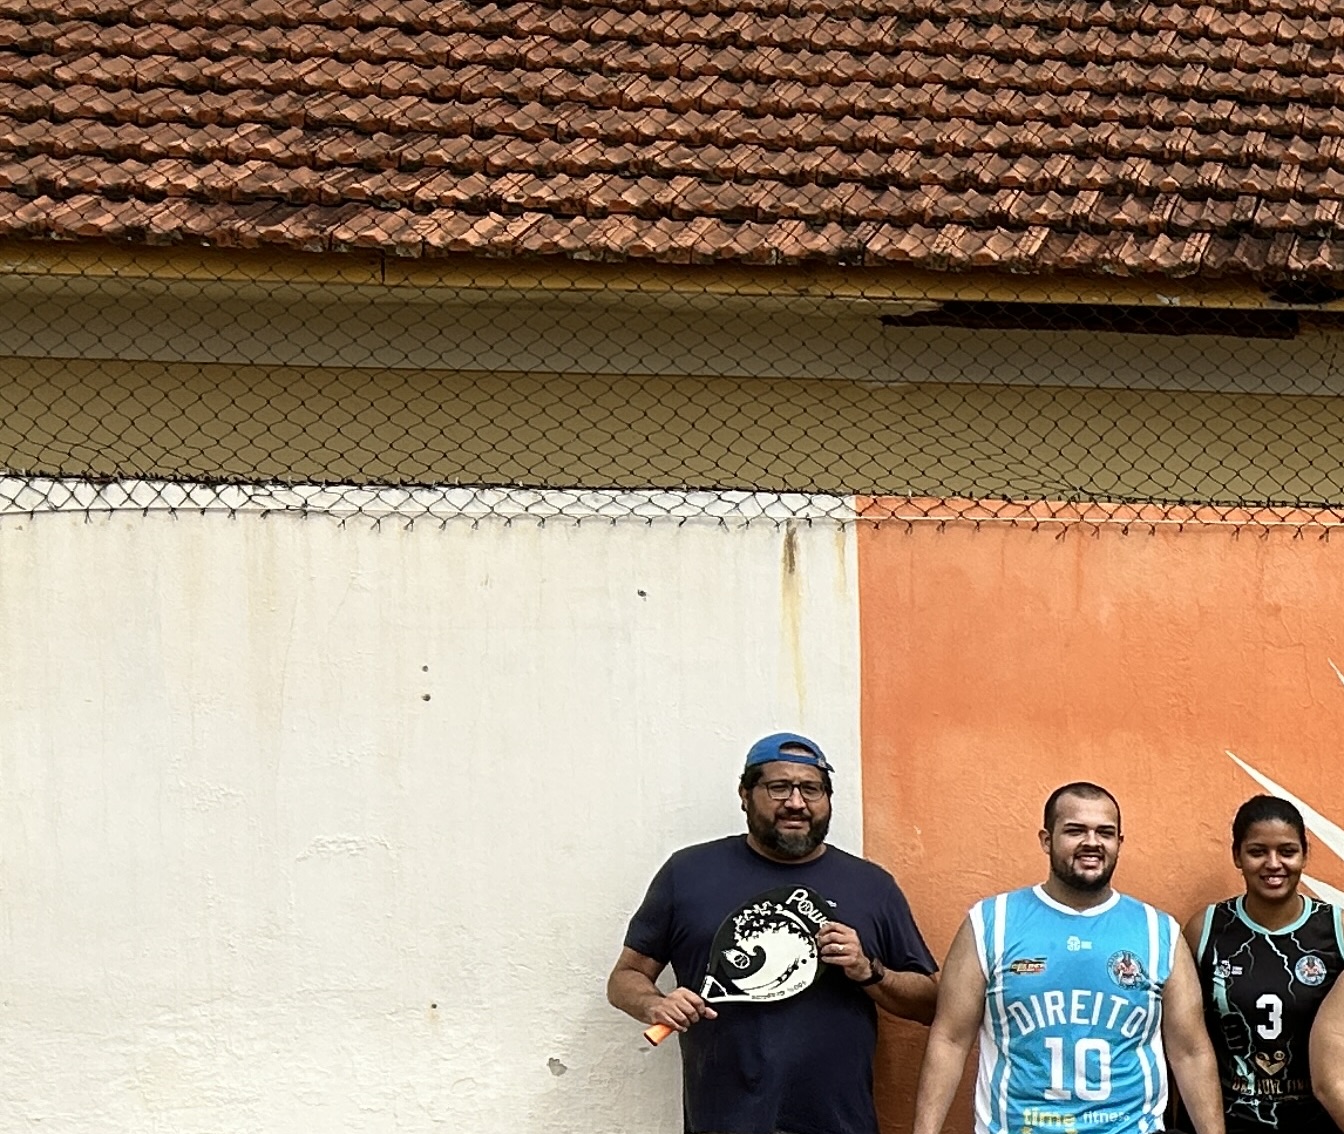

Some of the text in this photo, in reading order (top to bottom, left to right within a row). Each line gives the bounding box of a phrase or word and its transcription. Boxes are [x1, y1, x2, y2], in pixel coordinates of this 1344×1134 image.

[1007, 989, 1148, 1038] DIREITO
[1256, 993, 1283, 1040] 3
[1044, 1036, 1112, 1101] 10
